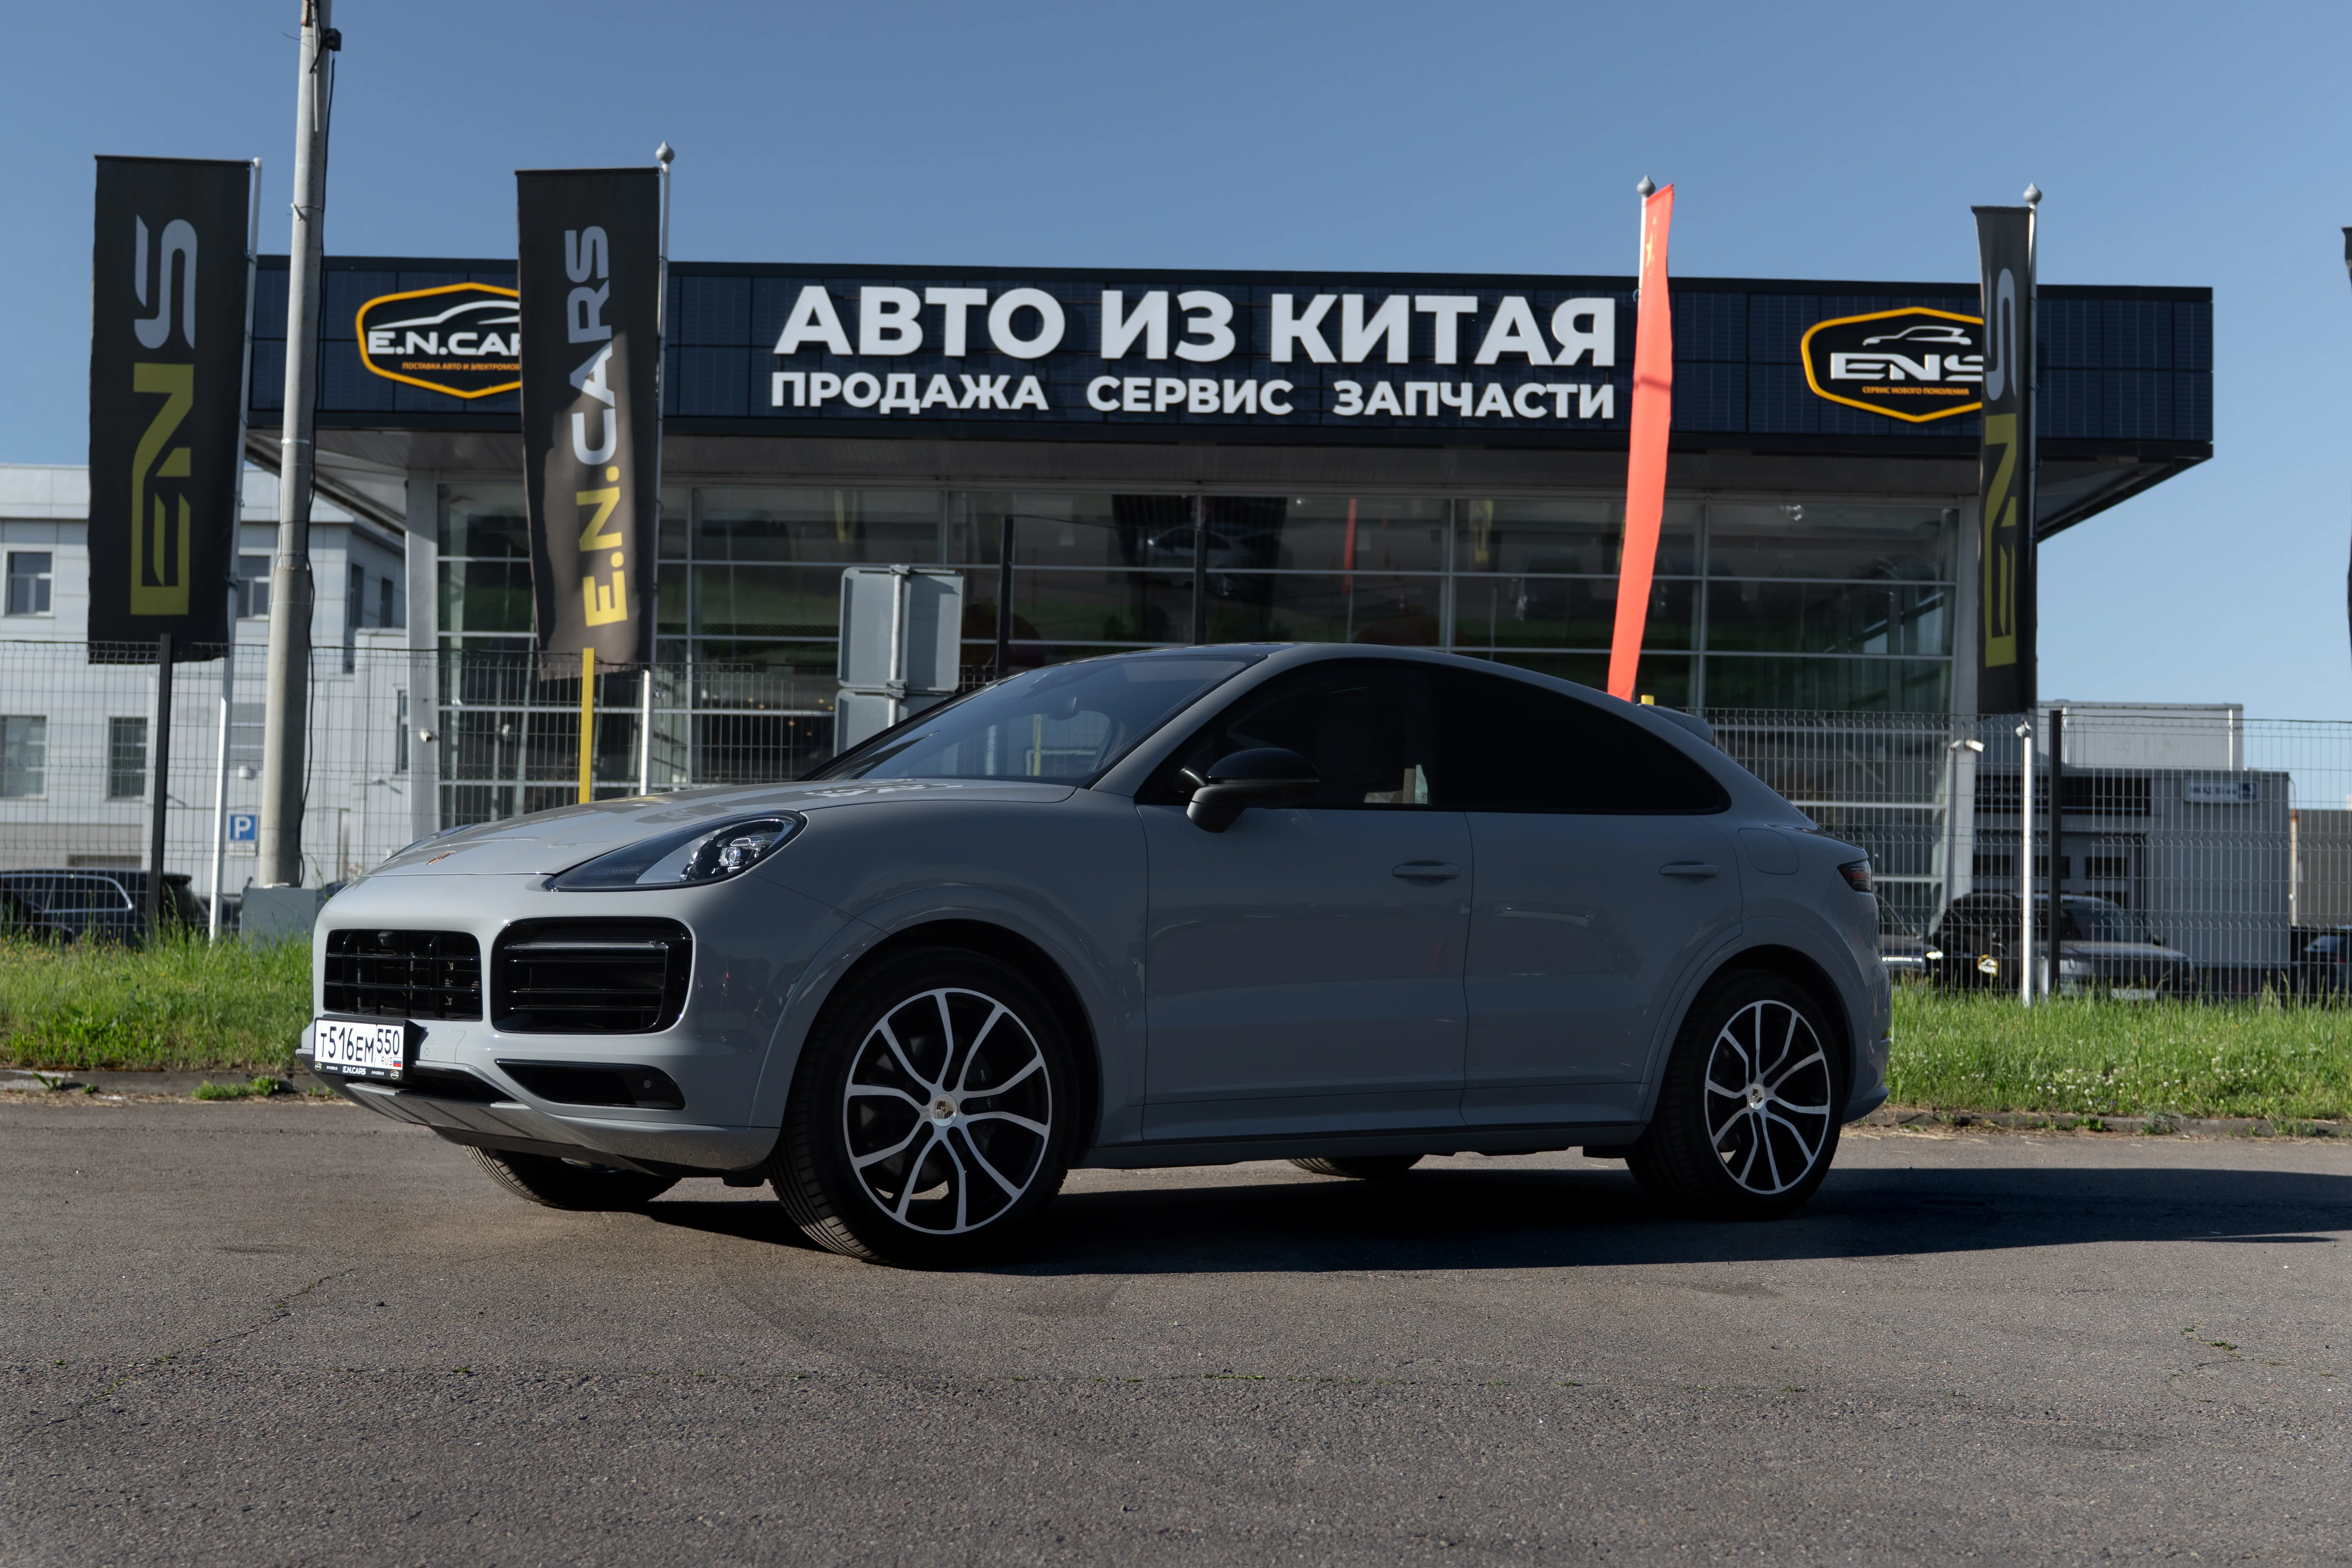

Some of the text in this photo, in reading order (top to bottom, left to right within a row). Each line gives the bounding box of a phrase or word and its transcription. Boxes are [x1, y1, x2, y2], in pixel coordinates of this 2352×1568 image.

[773, 286, 1615, 366] АВТО ИЗ КИТАЯ
[401, 361, 441, 370] ПОСТАВКА
[442, 362, 462, 370] АВТО
[1831, 353, 1983, 382] ENS
[771, 372, 1615, 419] ПРОДАЖА СЕРВИС ЗАПЧАСТИ
[1891, 387, 1922, 395] НОВОГО
[131, 214, 197, 615] ENS
[564, 226, 628, 626] E.N.CARS
[235, 816, 252, 839] P
[377, 1029, 399, 1055] 550
[381, 1056, 392, 1065] RUS
